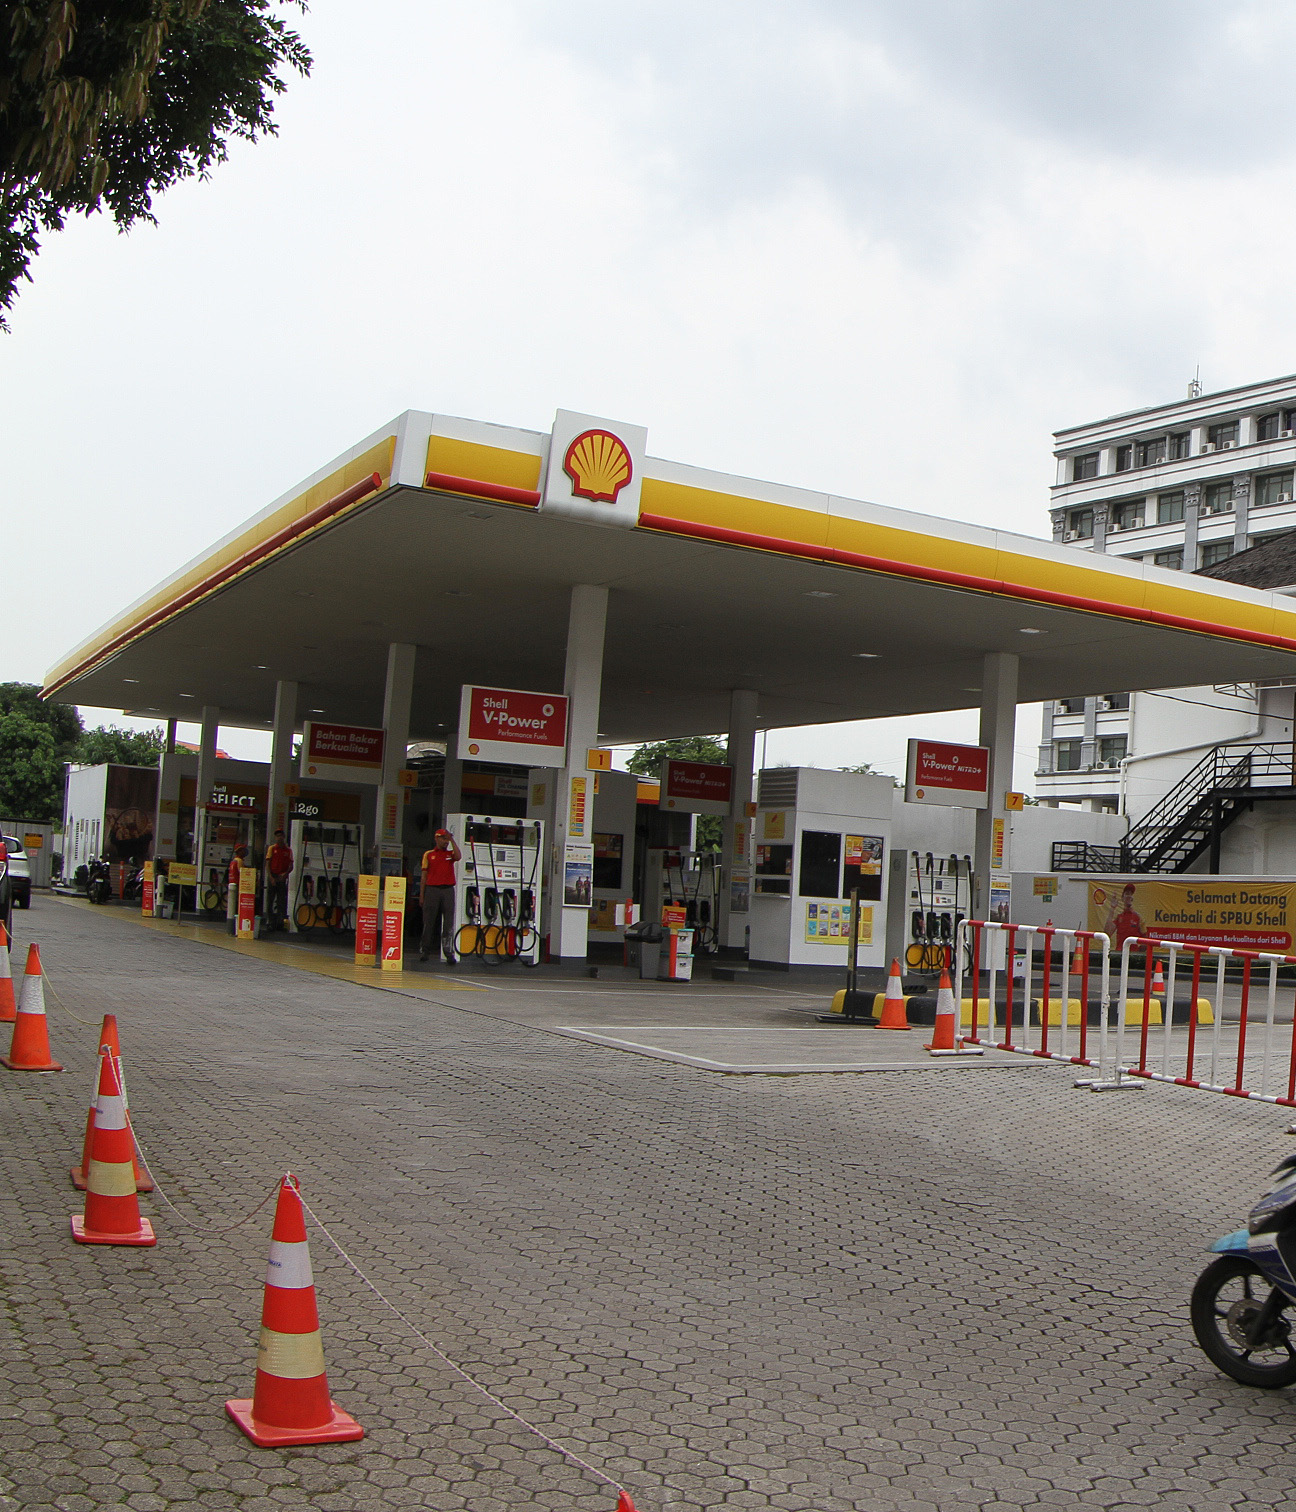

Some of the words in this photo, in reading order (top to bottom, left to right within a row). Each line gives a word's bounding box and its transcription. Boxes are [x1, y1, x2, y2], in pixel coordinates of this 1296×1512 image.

[483, 697, 508, 709] Shell
[483, 710, 547, 729] V-Power
[316, 730, 346, 741] Bahan
[349, 733, 379, 744] Bakar
[315, 740, 369, 754] Berkualitas
[598, 754, 604, 766] 1
[922, 752, 936, 760] Shell
[922, 760, 956, 771] V-Power
[406, 773, 413, 783] 3
[673, 776, 703, 785] V-Power
[1012, 796, 1019, 806] 7
[1186, 890, 1237, 905] Selamat
[1239, 893, 1287, 909] Datang
[1154, 909, 1203, 924] Kembali
[1205, 910, 1217, 924] di
[1219, 911, 1252, 926] SPBU
[1256, 911, 1287, 926] Shell
[1198, 934, 1223, 943] Layanan
[1223, 935, 1257, 943] Berkualitas
[1257, 936, 1270, 944] dari
[1271, 936, 1287, 944] Shell
